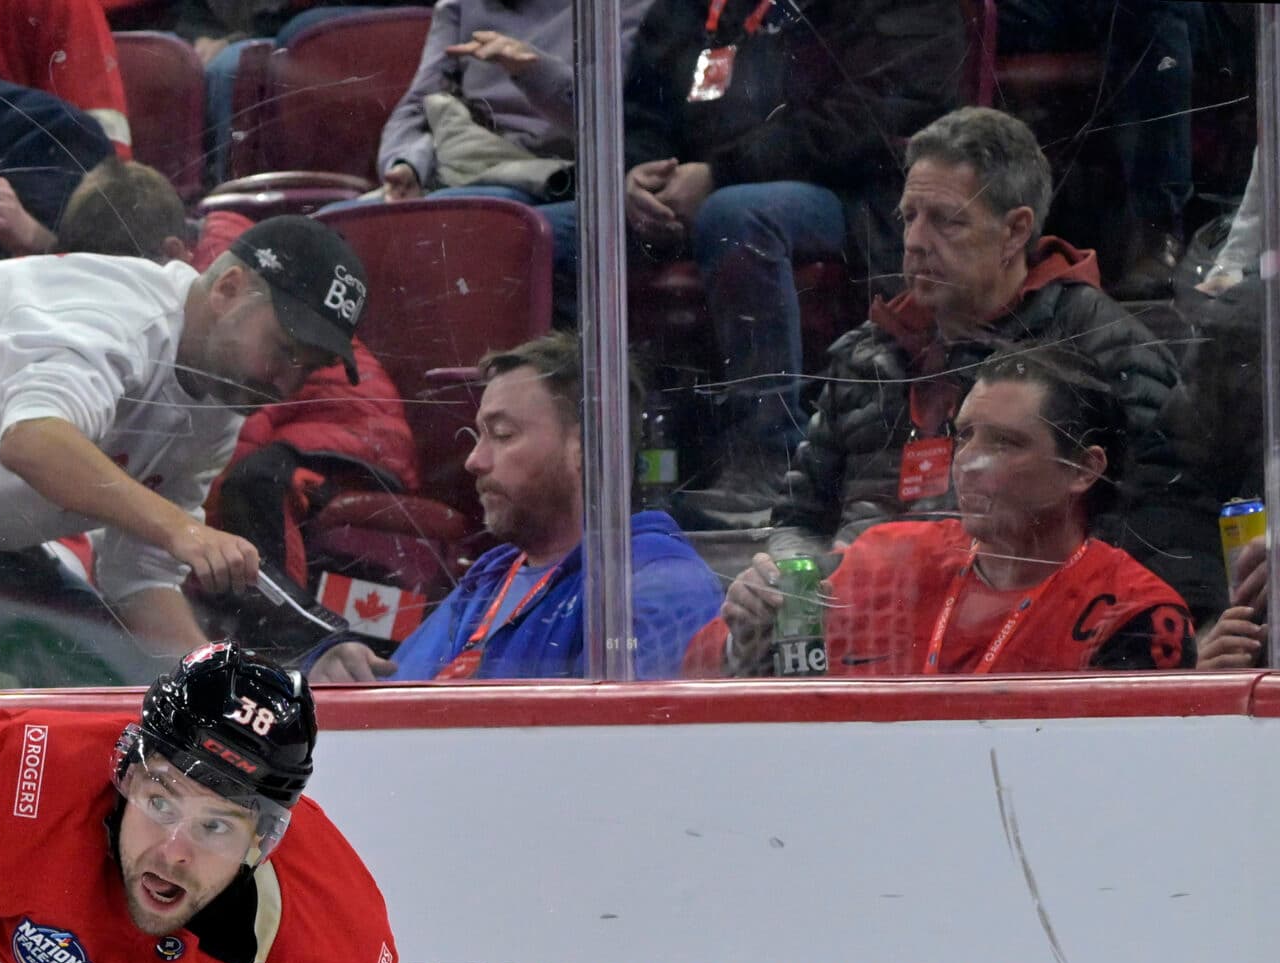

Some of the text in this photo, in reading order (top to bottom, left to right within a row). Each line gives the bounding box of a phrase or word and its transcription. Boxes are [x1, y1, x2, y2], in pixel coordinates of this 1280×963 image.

[234, 696, 276, 737] 38
[202, 738, 258, 774] CCM
[18, 742, 42, 815] ROGERS
